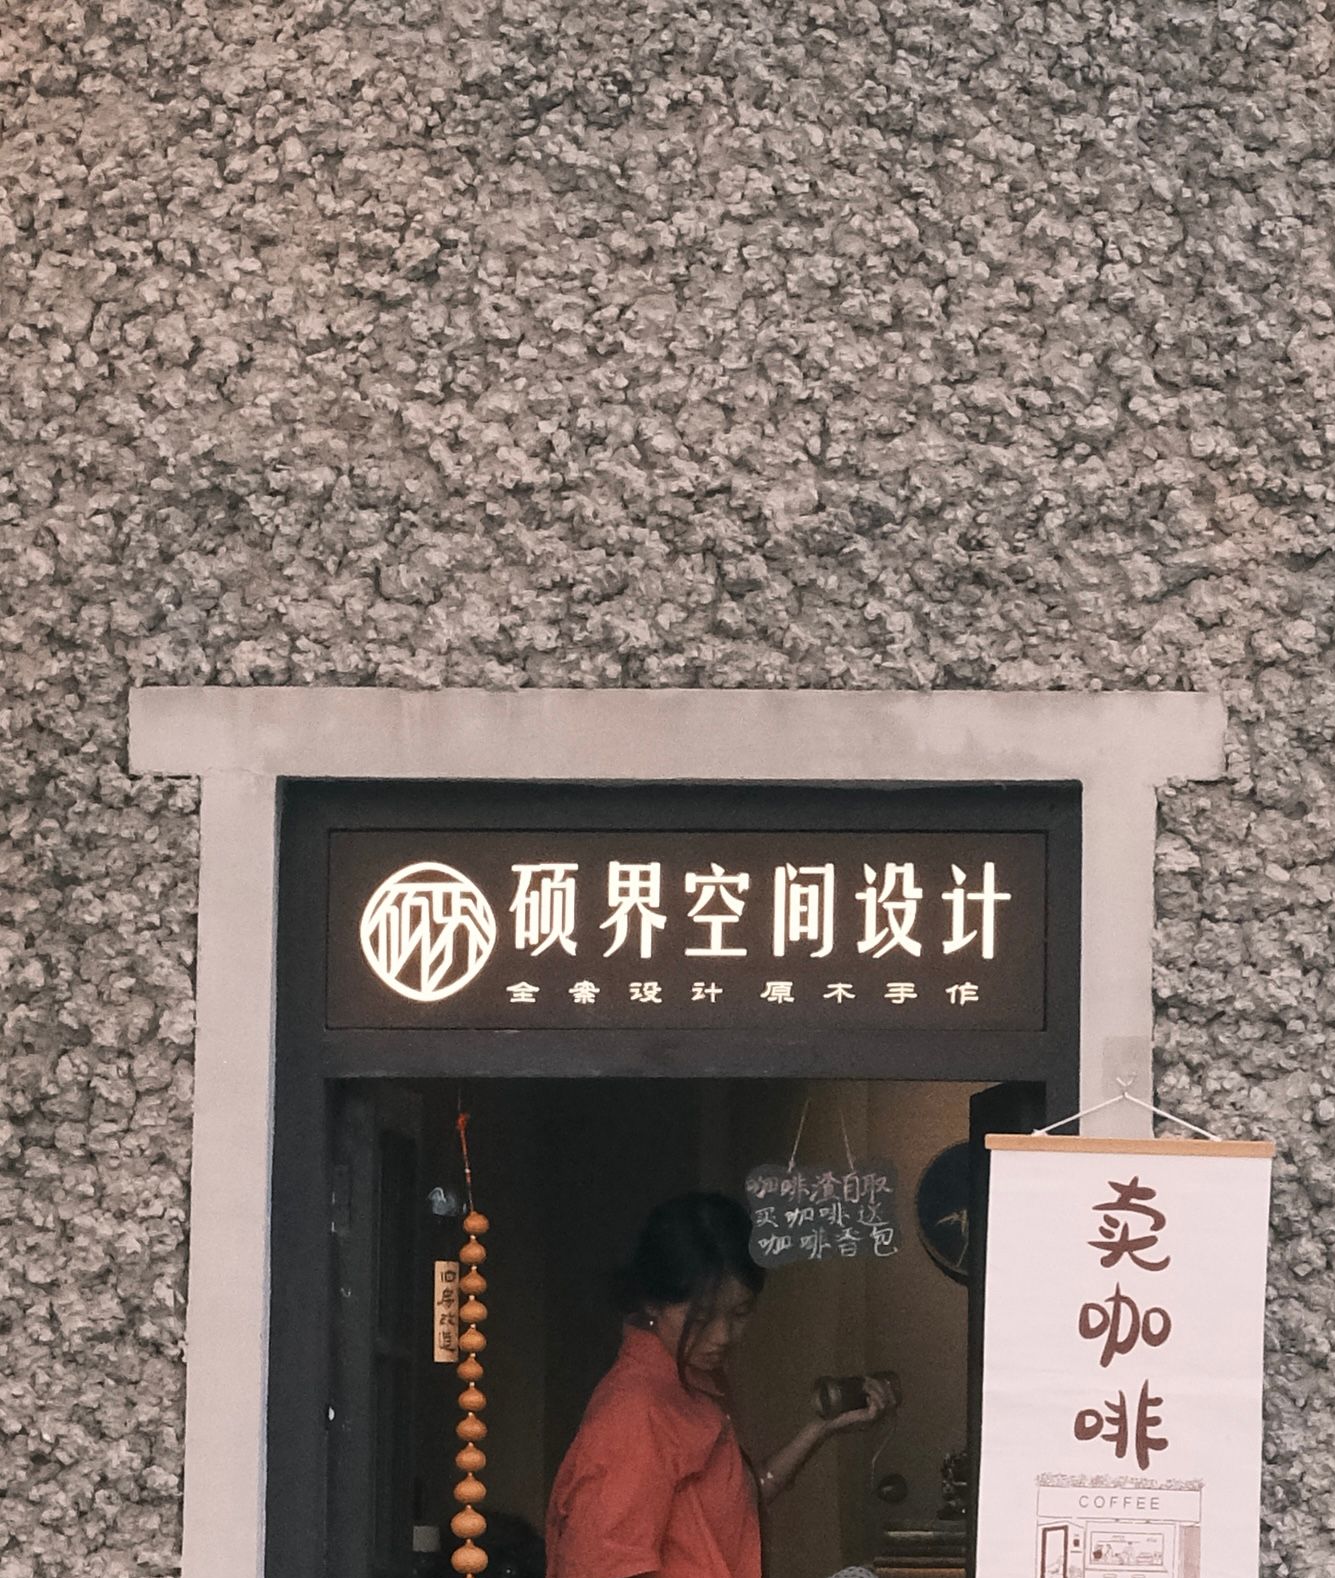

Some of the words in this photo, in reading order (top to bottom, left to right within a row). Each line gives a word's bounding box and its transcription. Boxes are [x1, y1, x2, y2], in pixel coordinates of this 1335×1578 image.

[509, 861, 1012, 959] 硕界空间设计
[746, 1171, 893, 1204] 咖啡渣自取
[754, 1202, 890, 1228] 买咖啡送
[1074, 1176, 1172, 1471] 卖咖啡
[1079, 1495, 1160, 1510] COFFEE
